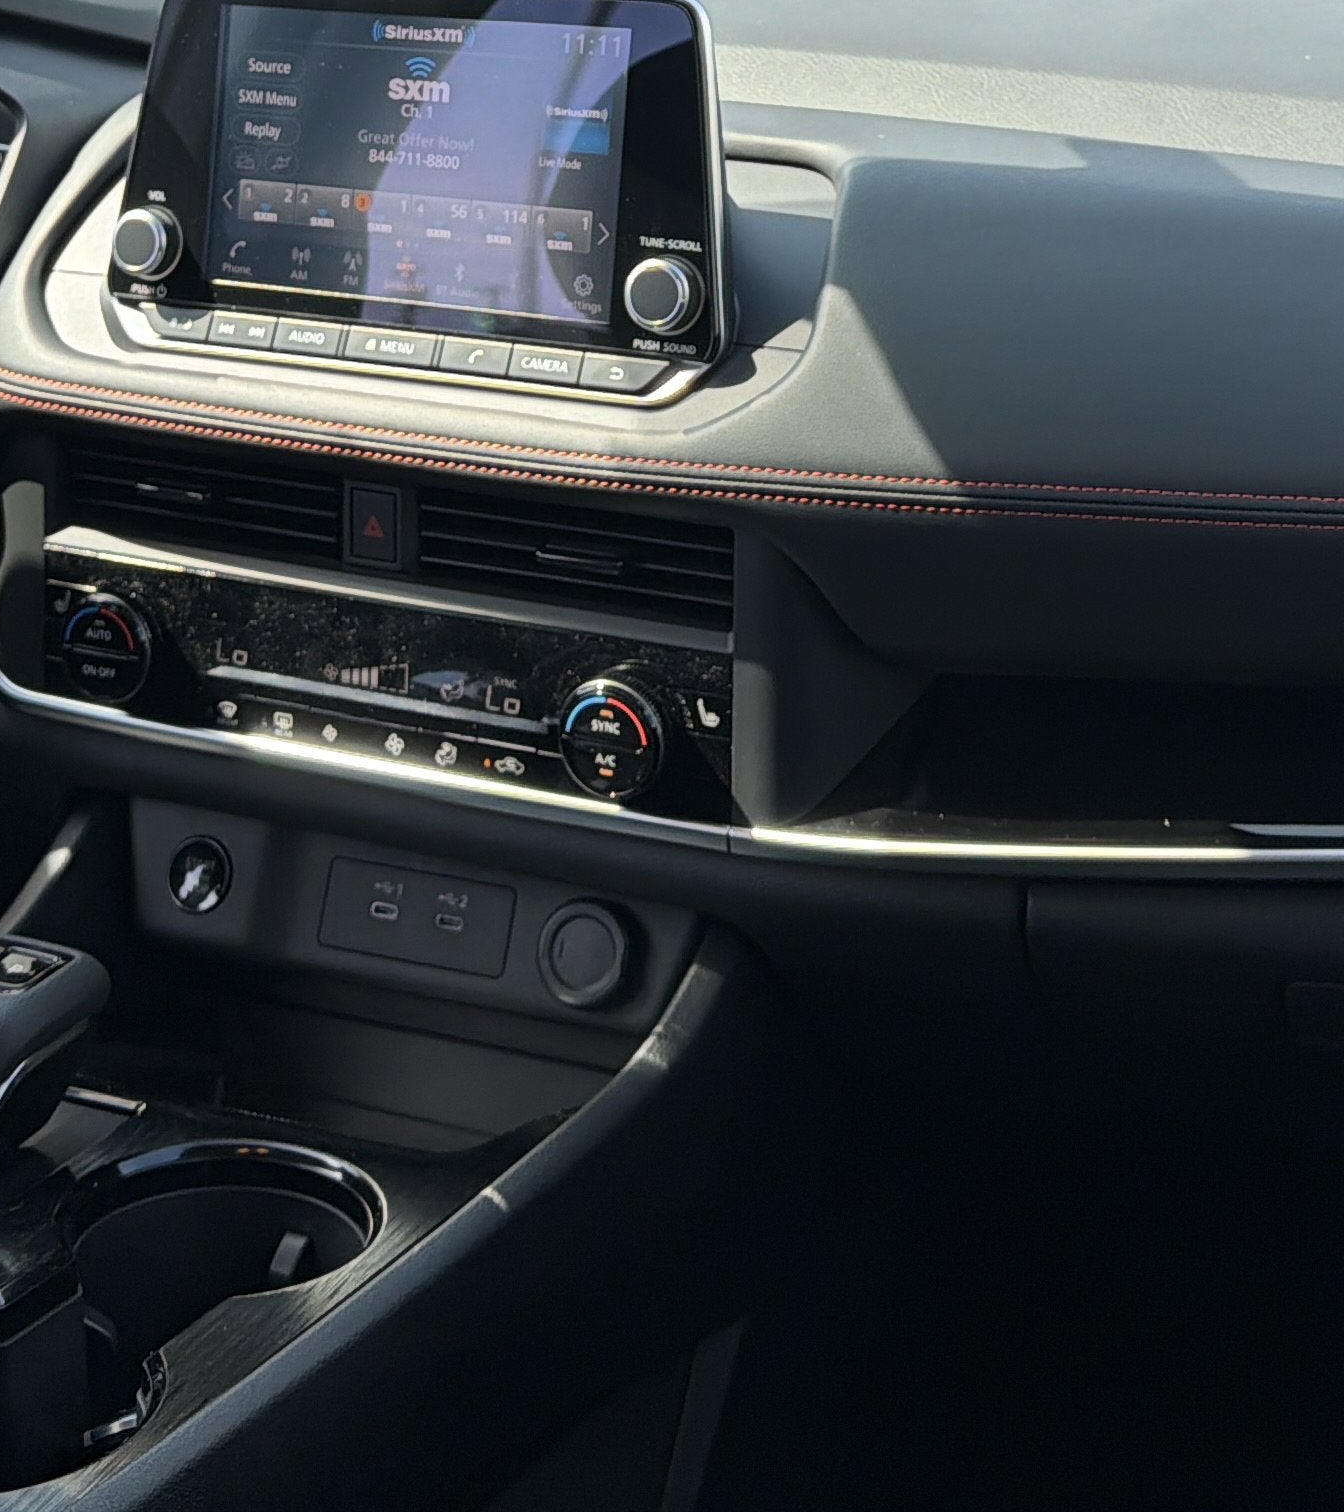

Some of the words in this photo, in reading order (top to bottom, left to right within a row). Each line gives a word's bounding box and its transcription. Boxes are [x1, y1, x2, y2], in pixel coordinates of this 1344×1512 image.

[563, 33, 621, 57] 11:11
[248, 57, 291, 74] Source
[388, 78, 450, 103] sxm
[239, 89, 263, 104] SXM
[266, 92, 297, 107] Menu
[401, 104, 421, 118] Ch.
[244, 121, 281, 141] Replay
[358, 129, 395, 144] Great
[399, 132, 435, 148] Offer
[438, 137, 474, 151] Now!
[368, 149, 460, 169] 844-711-8800
[539, 156, 555, 167] Live
[557, 157, 581, 170] Mode
[147, 190, 167, 201] VOL
[284, 189, 292, 203] 2
[341, 194, 350, 208] 8
[254, 212, 278, 222] sxm
[450, 205, 468, 218] 56
[503, 210, 528, 224] 114
[310, 217, 334, 228] sxm
[367, 222, 392, 233] sxm
[426, 228, 451, 239] sxm
[486, 234, 511, 245] sxm
[547, 240, 573, 251] sxm
[222, 262, 251, 274] Phone
[290, 270, 308, 280] AM
[343, 275, 358, 285] FM
[130, 284, 156, 295] PUSH
[288, 330, 326, 345] AUDIO
[379, 340, 415, 354] MENU
[633, 338, 660, 351] PUSH
[663, 343, 696, 354] SOUND
[521, 356, 568, 373] CAMERA
[86, 628, 112, 641] AUTO
[494, 675, 518, 688] SYNC
[485, 685, 521, 714] Lo
[591, 719, 621, 736] SYNC
[595, 753, 617, 767] A/C
